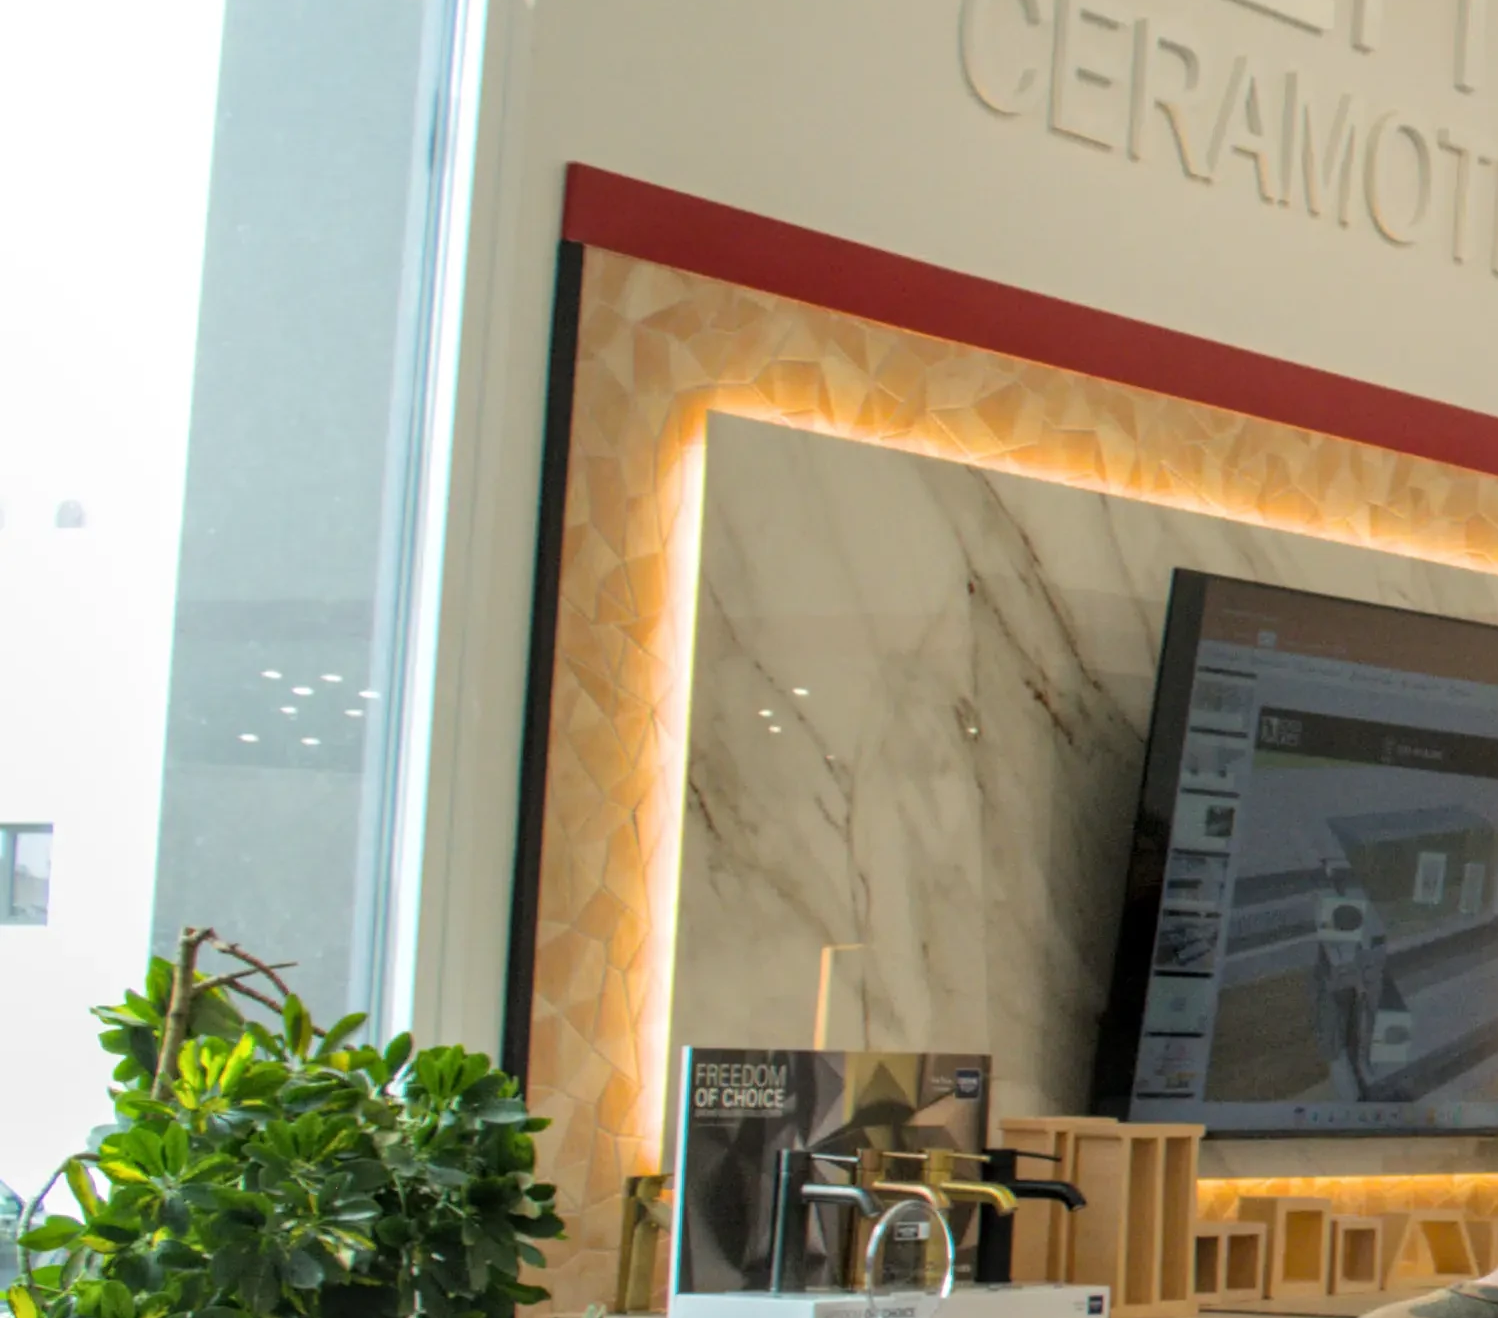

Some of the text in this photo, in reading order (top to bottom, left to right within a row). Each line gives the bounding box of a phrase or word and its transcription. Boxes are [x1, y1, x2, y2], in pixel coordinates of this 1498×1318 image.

[695, 1063, 787, 1088] FREEDOM
[695, 1087, 786, 1108] OF CHOICE
